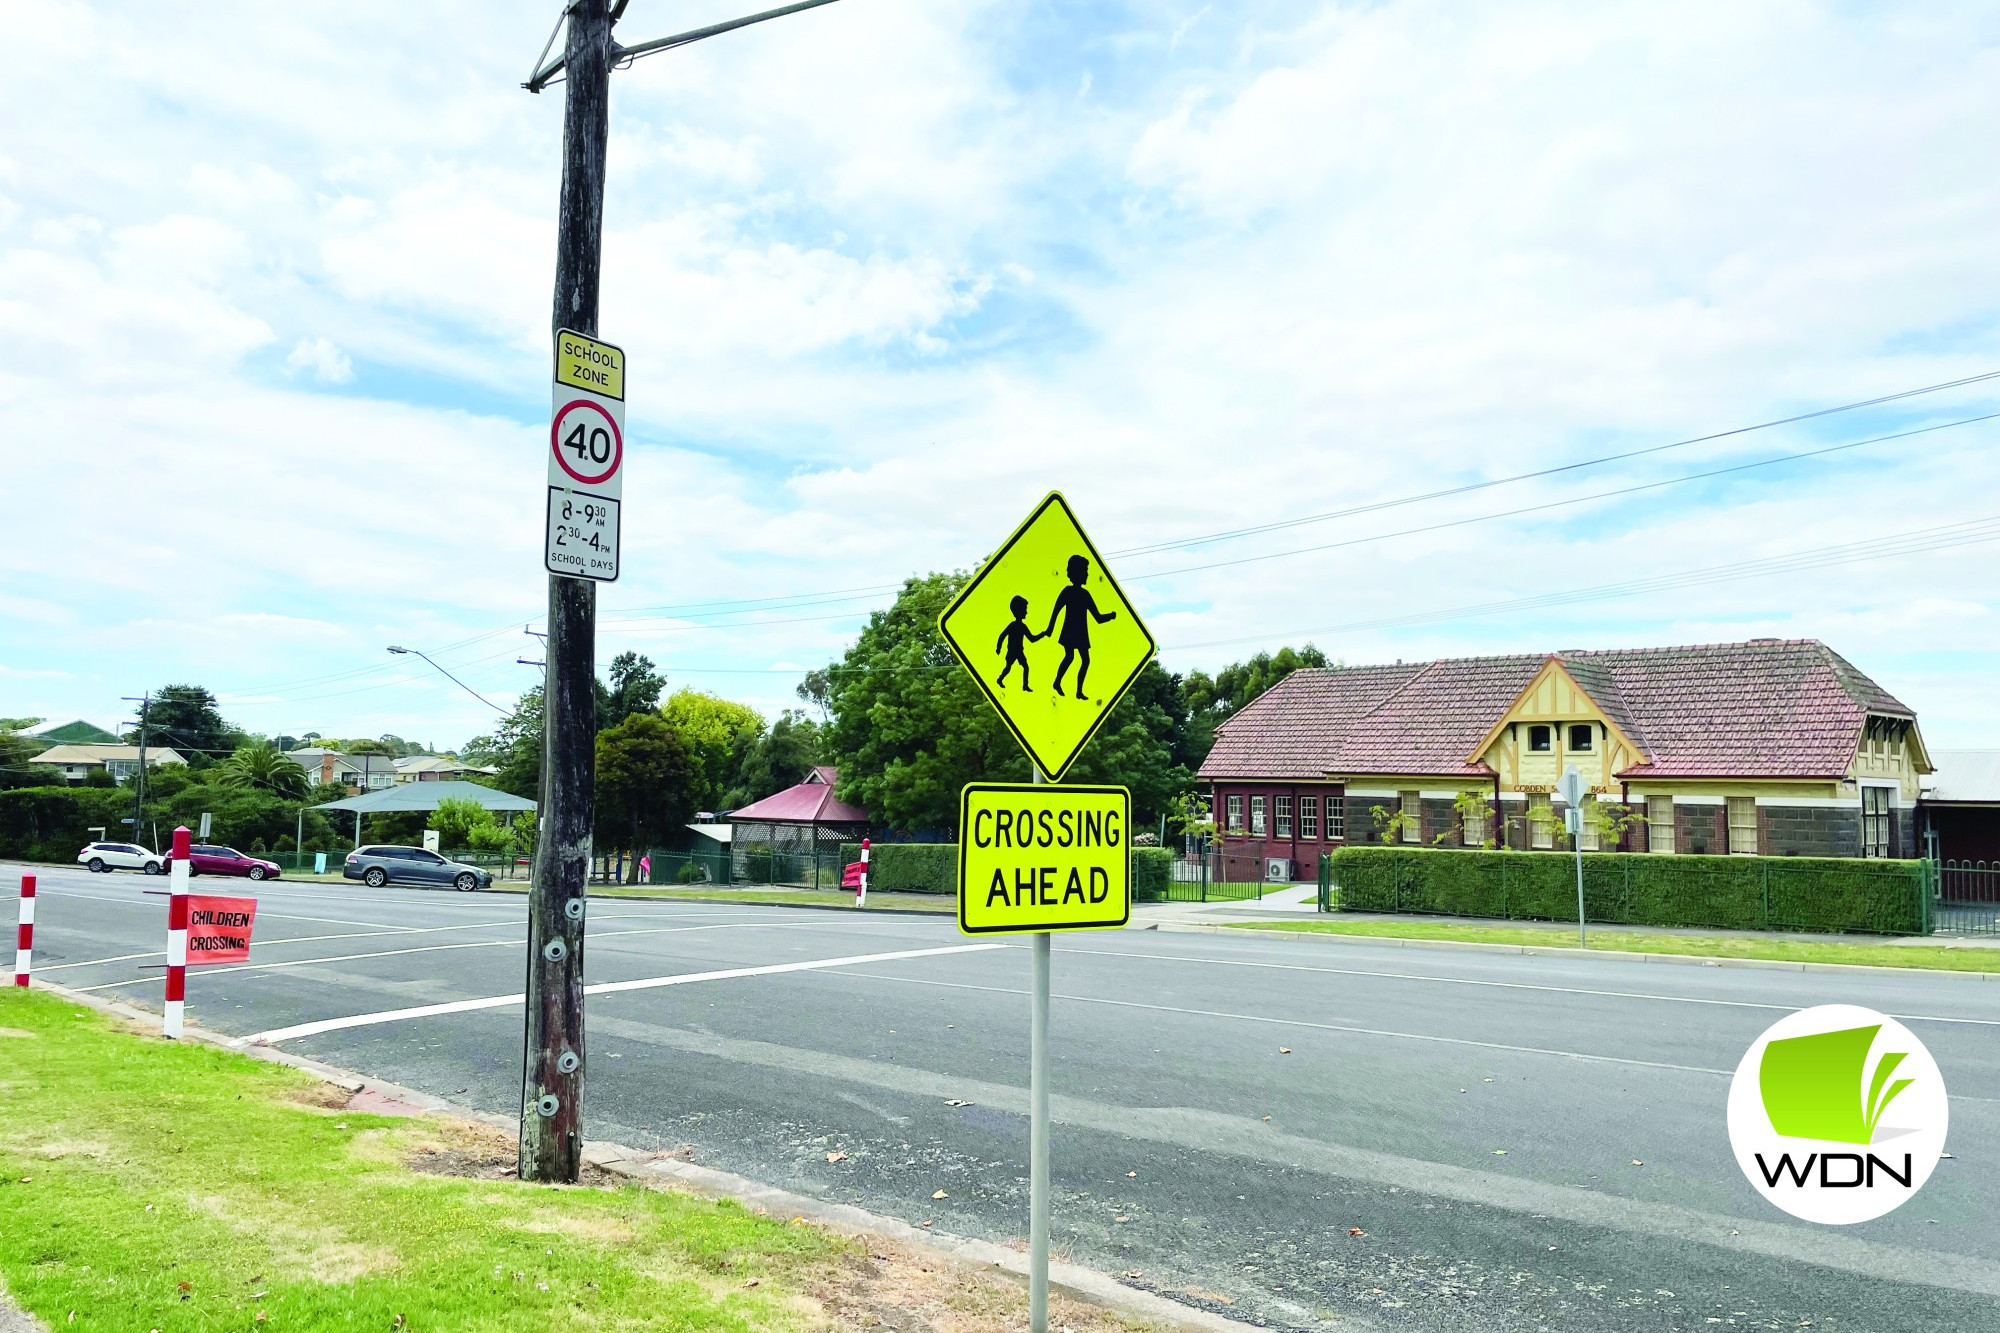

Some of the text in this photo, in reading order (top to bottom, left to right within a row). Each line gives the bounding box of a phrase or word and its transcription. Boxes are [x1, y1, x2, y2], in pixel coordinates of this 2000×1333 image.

[564, 342, 618, 370] SCHOOL
[573, 364, 609, 387] ZONE
[564, 423, 610, 464] 40
[551, 552, 614, 571] SCHOOL DAYS
[1513, 785, 1546, 793] COBDEN
[1591, 786, 1607, 794] 864
[974, 808, 1120, 848] CROSSING
[985, 866, 1109, 908] AHEAD
[191, 910, 249, 927] CHILDREN
[190, 936, 245, 951] CROSSING
